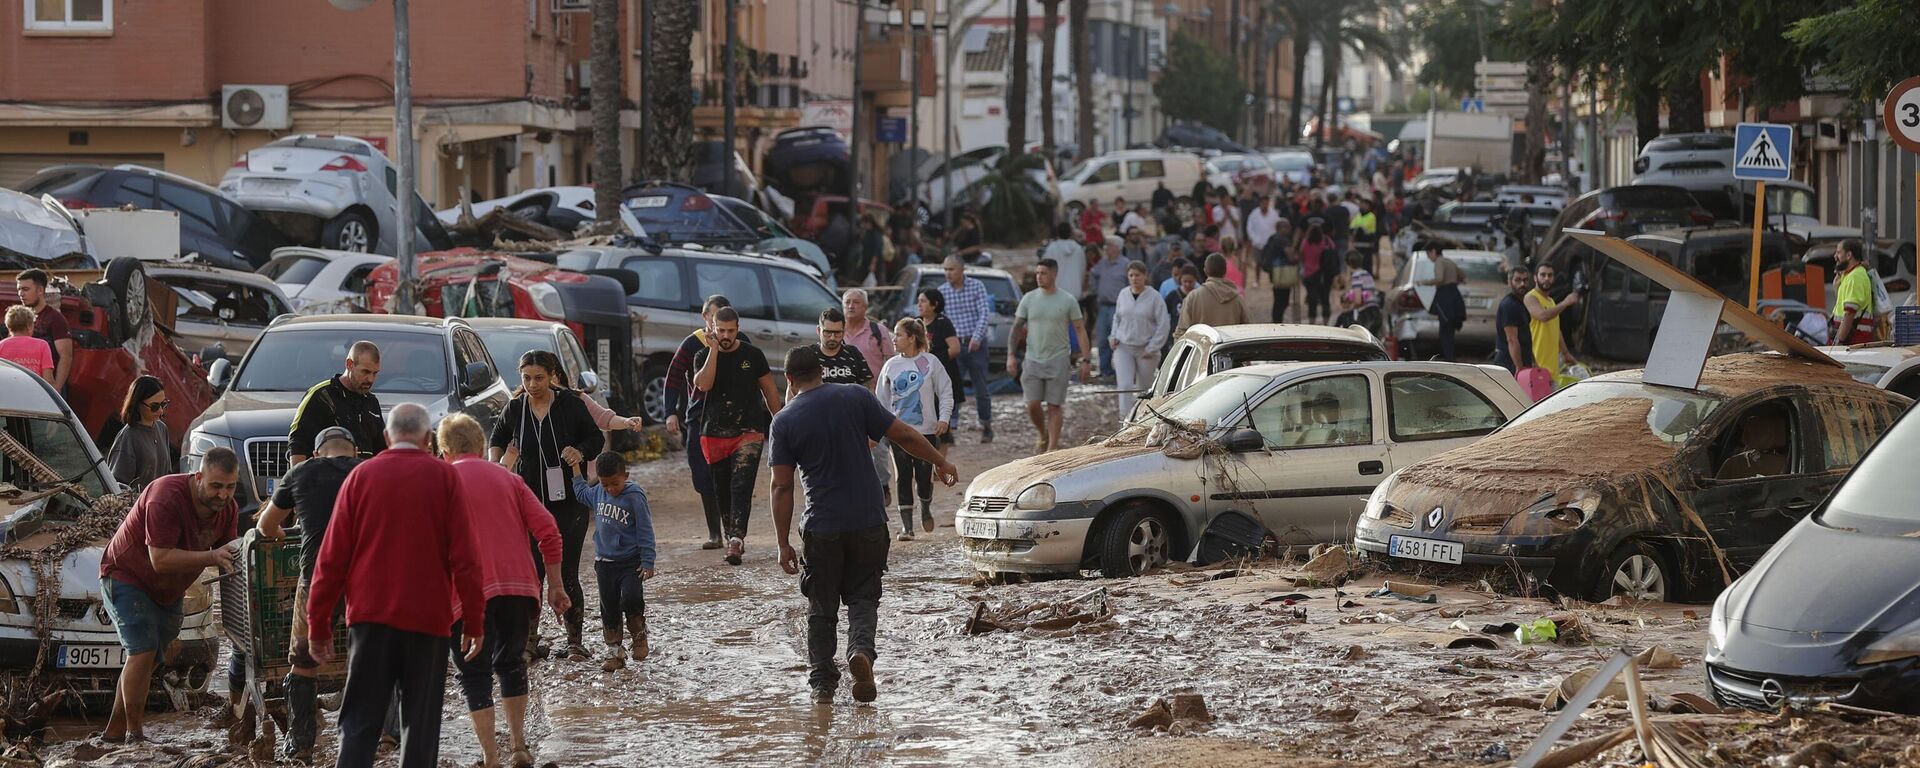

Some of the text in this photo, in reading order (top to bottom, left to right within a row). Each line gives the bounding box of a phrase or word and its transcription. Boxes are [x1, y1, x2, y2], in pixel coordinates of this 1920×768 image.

[821, 366, 852, 378] didas
[1397, 540, 1457, 562] 4581 FFL
[70, 648, 110, 665] 9051
